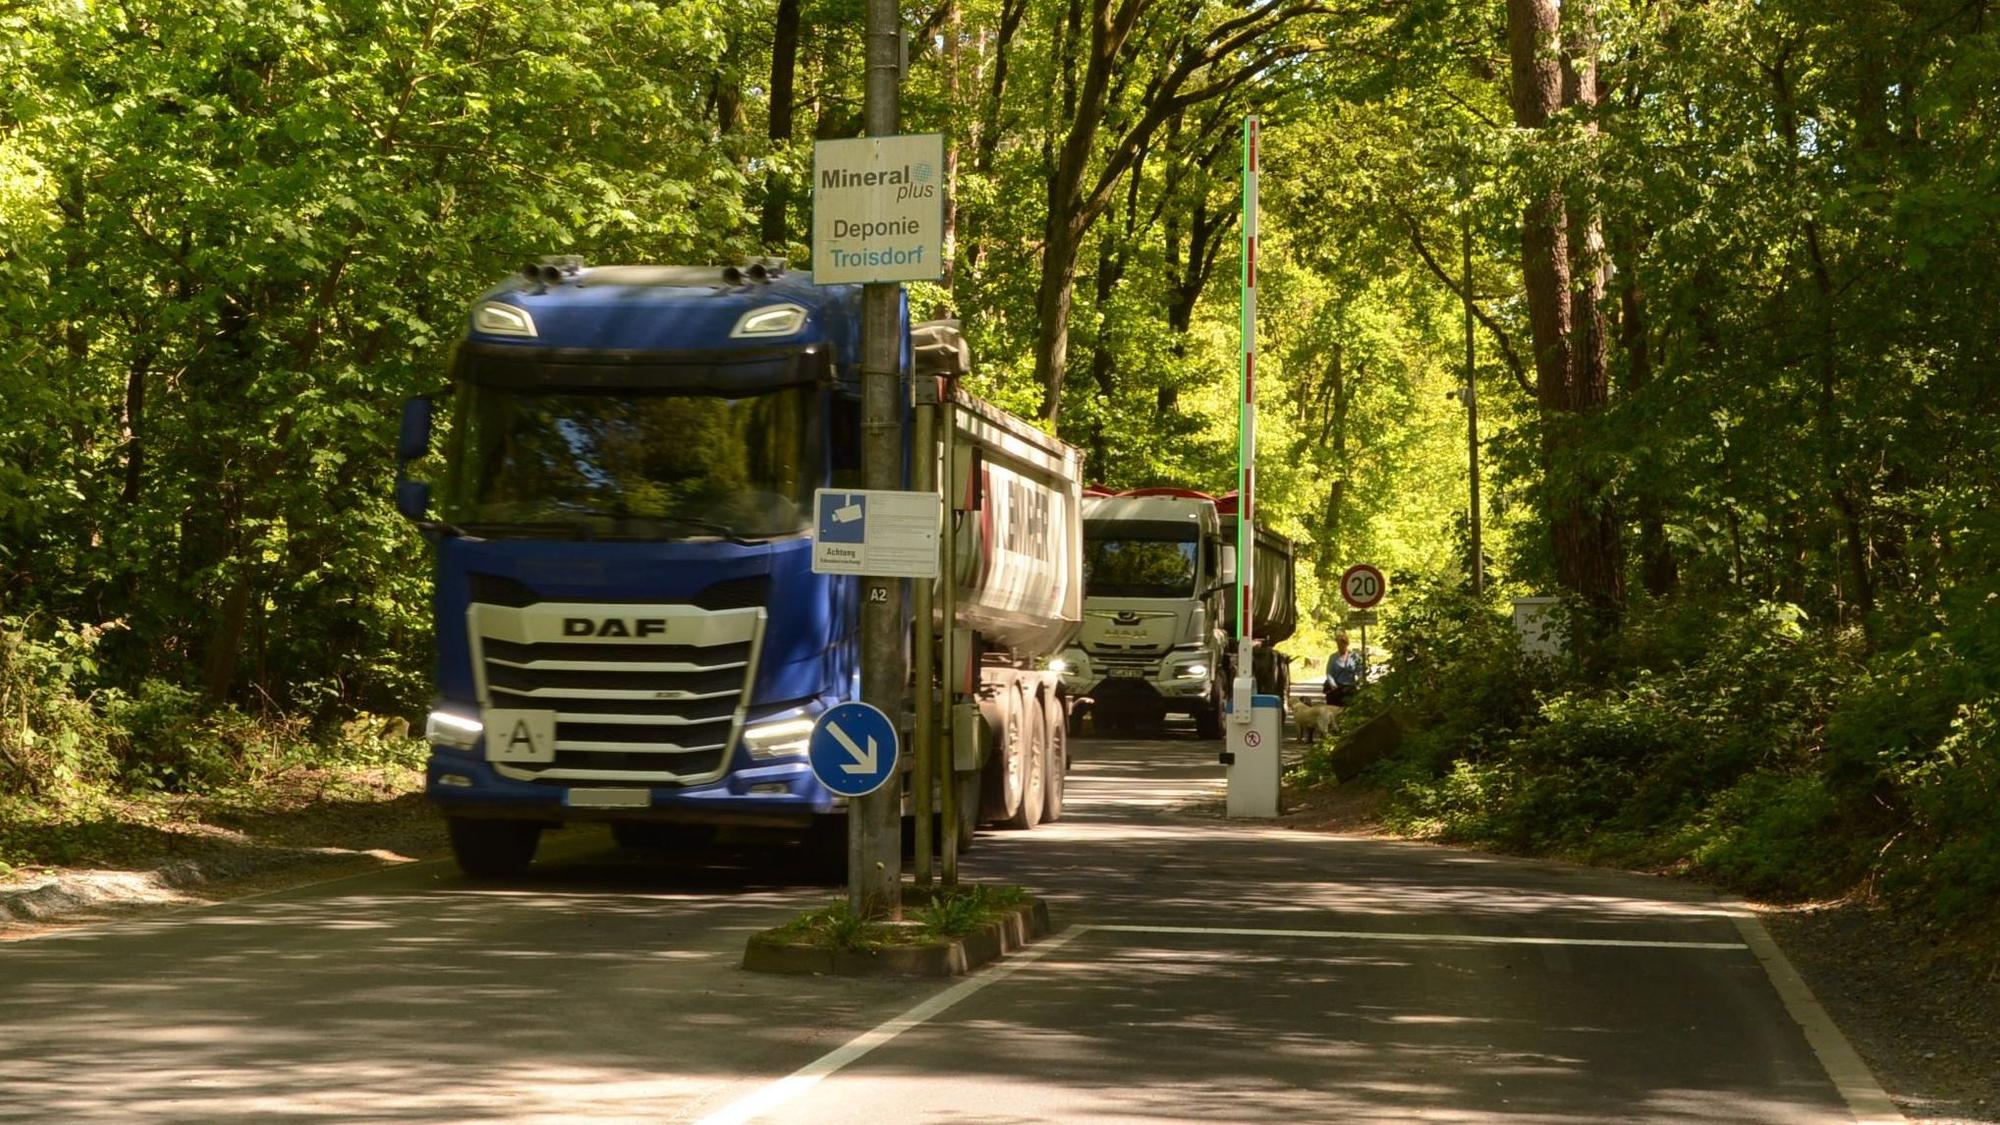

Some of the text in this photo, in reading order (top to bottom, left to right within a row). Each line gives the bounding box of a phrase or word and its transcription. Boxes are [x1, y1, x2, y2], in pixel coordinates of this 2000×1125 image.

[821, 164, 910, 189] Mineral
[896, 182, 934, 203] plus
[834, 216, 920, 241] Deponie
[830, 245, 924, 267] Troisdorf
[870, 588, 887, 602] A2
[1351, 576, 1376, 597] 20
[562, 617, 667, 638] DAF
[505, 718, 537, 754] A
